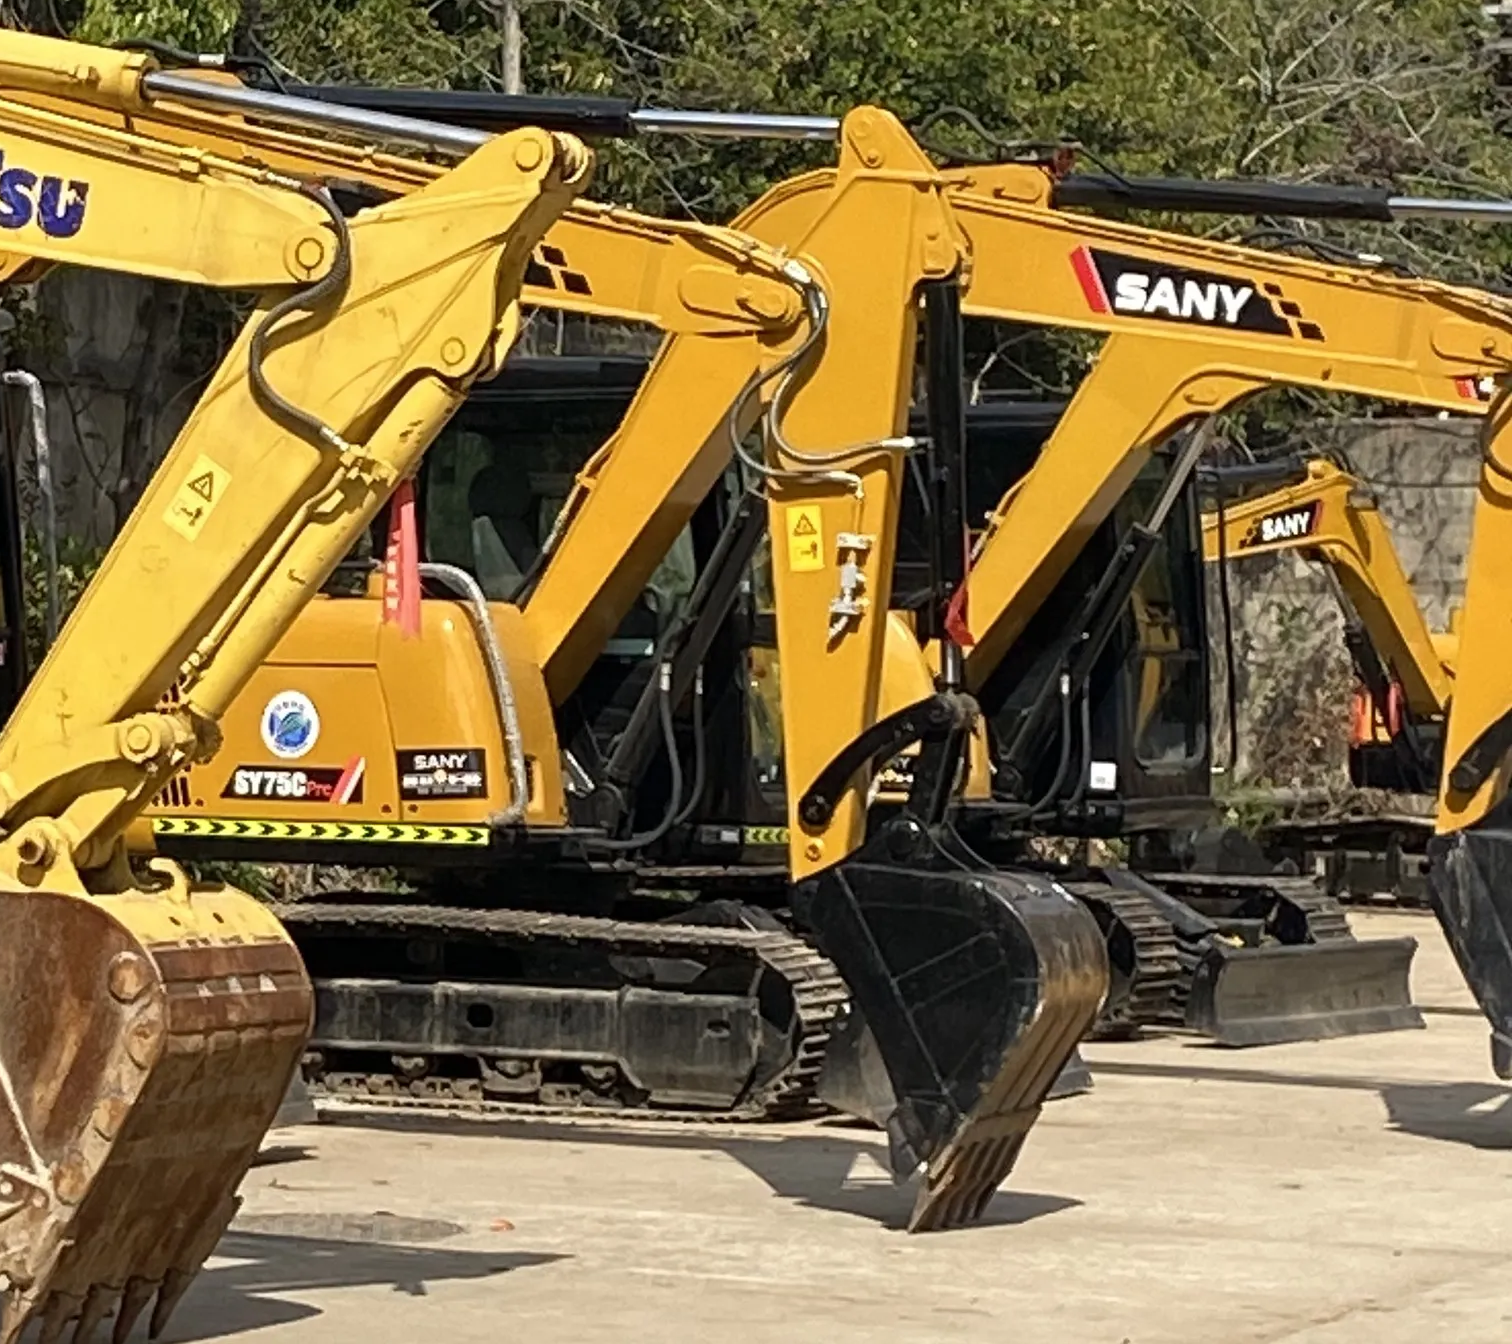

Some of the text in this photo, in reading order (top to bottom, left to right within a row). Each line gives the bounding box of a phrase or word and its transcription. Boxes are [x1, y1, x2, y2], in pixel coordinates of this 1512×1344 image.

[1115, 272, 1252, 323] SANY
[1262, 512, 1310, 541] SANY
[414, 754, 467, 770] SANY
